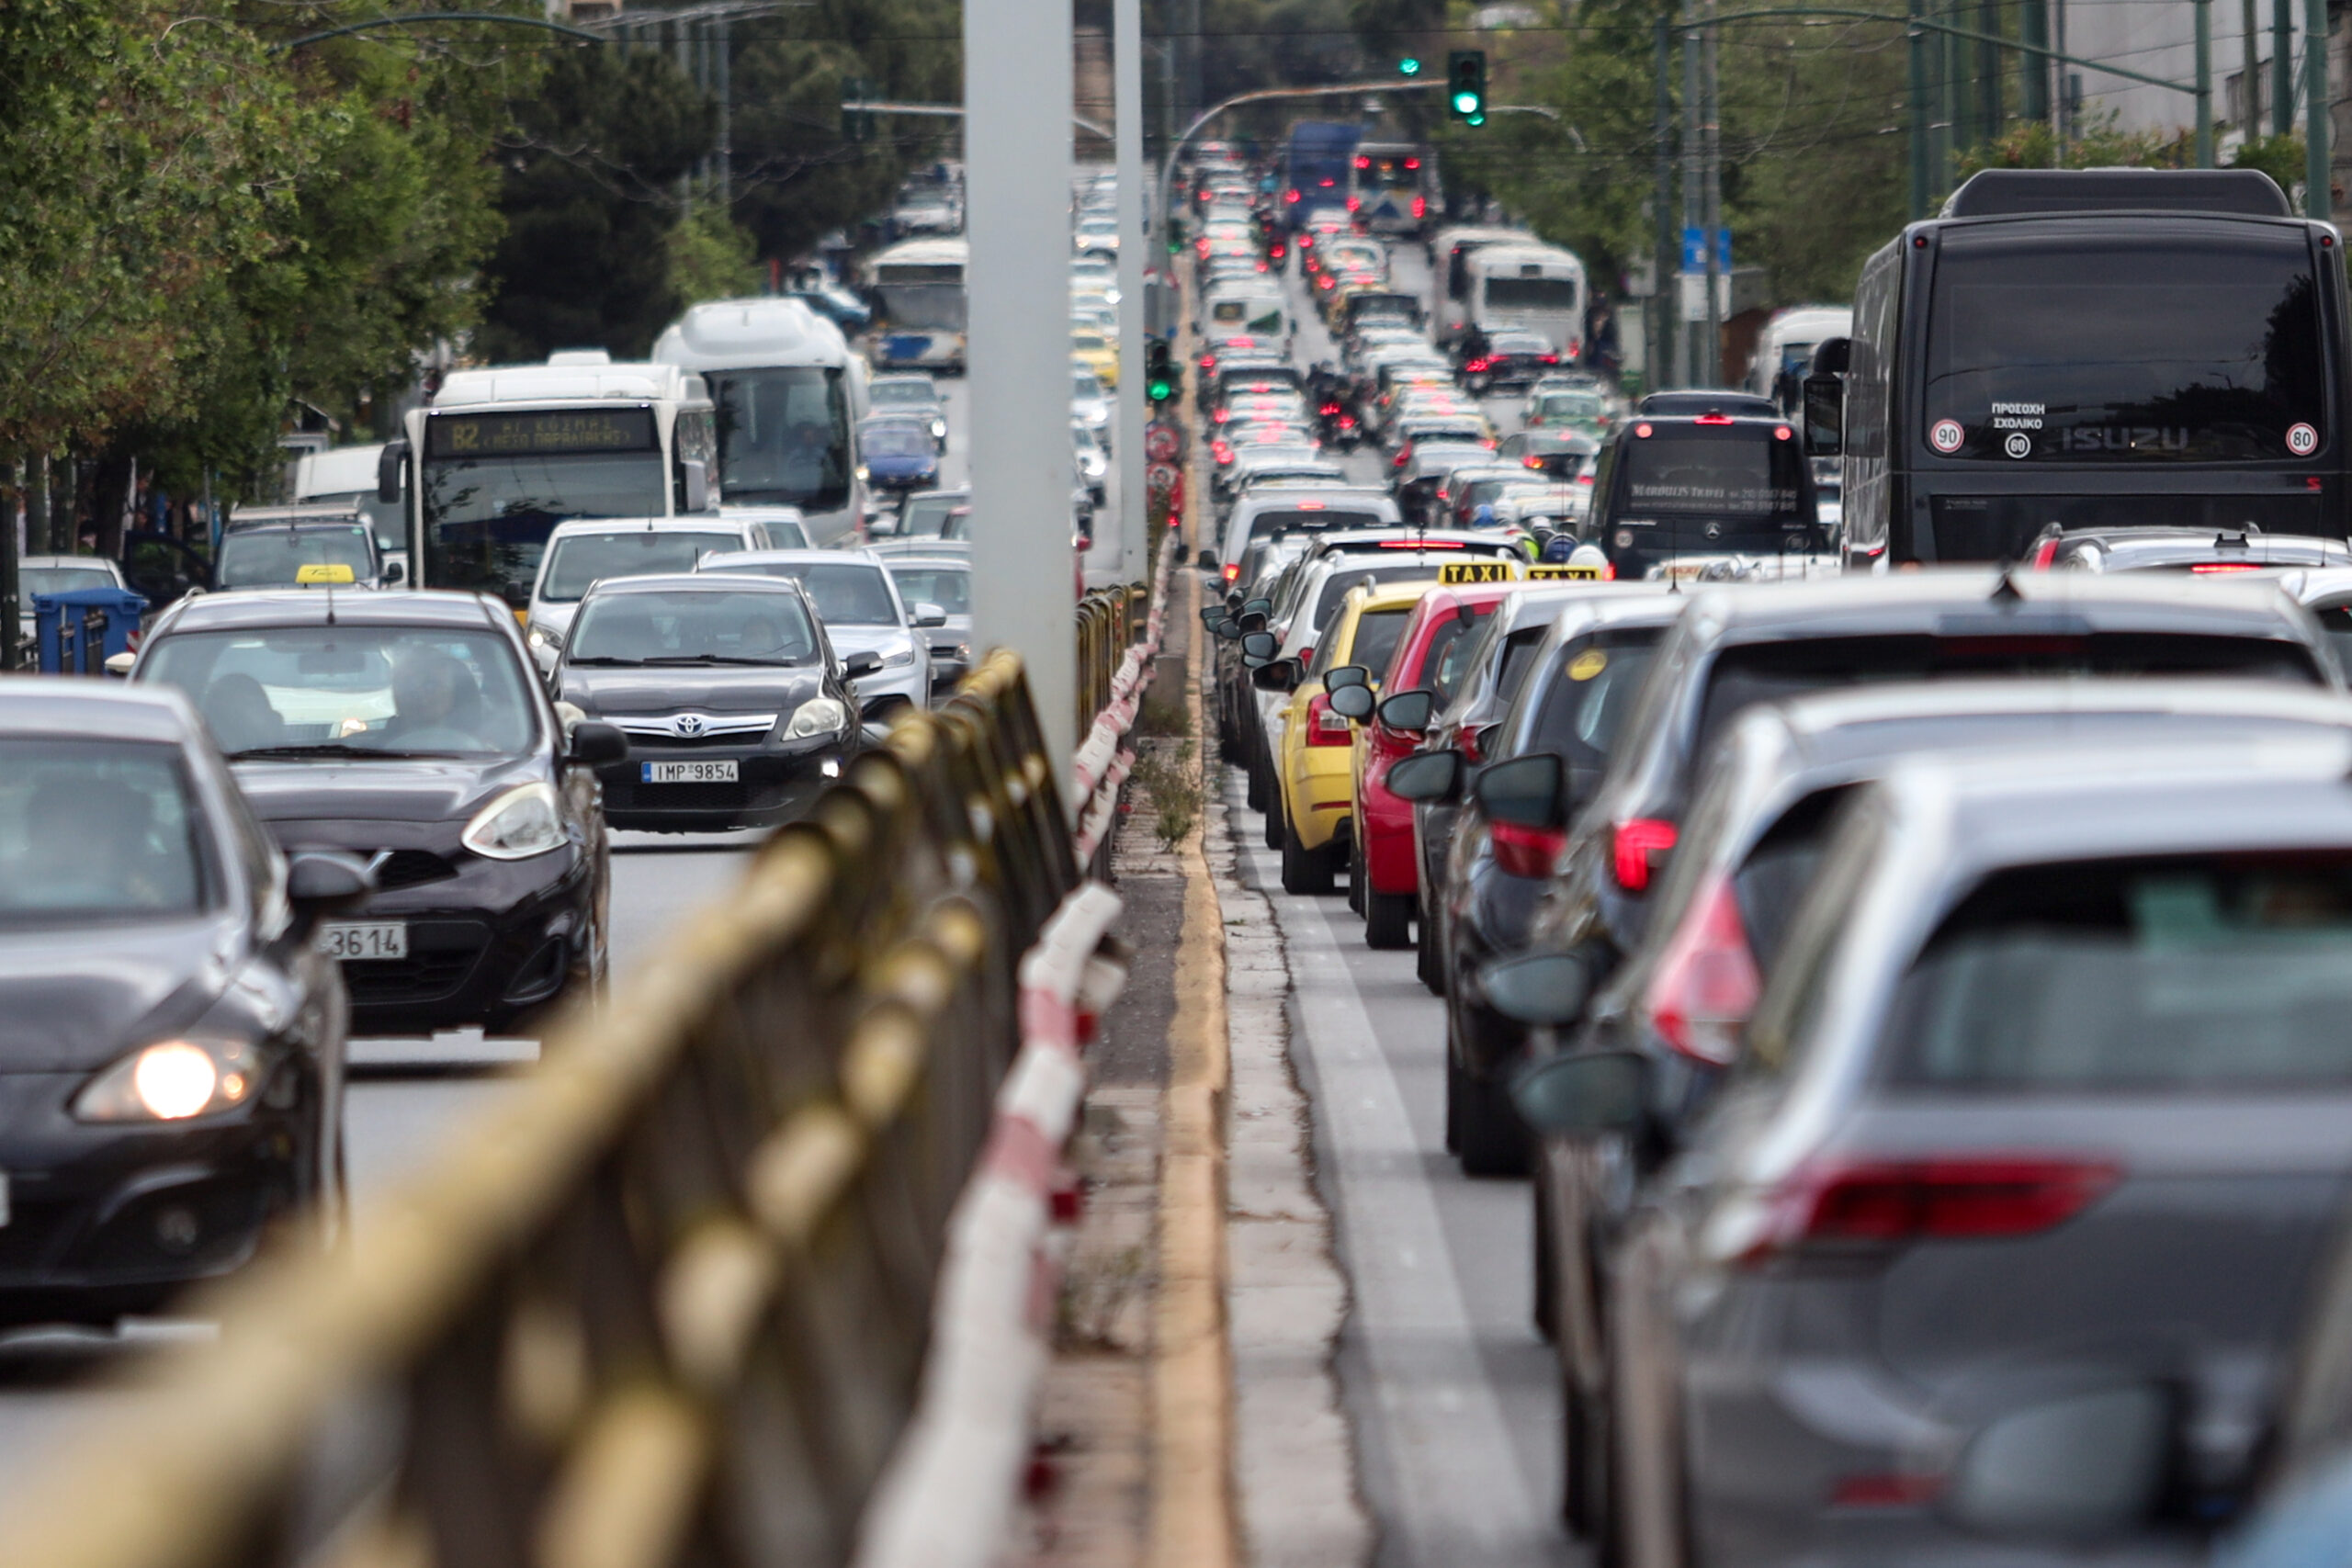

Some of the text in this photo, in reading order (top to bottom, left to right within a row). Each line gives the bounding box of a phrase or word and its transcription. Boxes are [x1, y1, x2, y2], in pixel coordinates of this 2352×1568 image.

[1991, 402, 2045, 415] ΠΡΟΣΟΧΗ
[1993, 418, 2043, 430] ΣΧΟΛΙΚΟ
[1938, 428, 1958, 445] 90
[2062, 426, 2188, 451] ISUZU
[2293, 431, 2312, 447] 80
[2009, 439, 2027, 452] 60
[1448, 566, 1503, 582] TAXI
[330, 928, 400, 956] 3614
